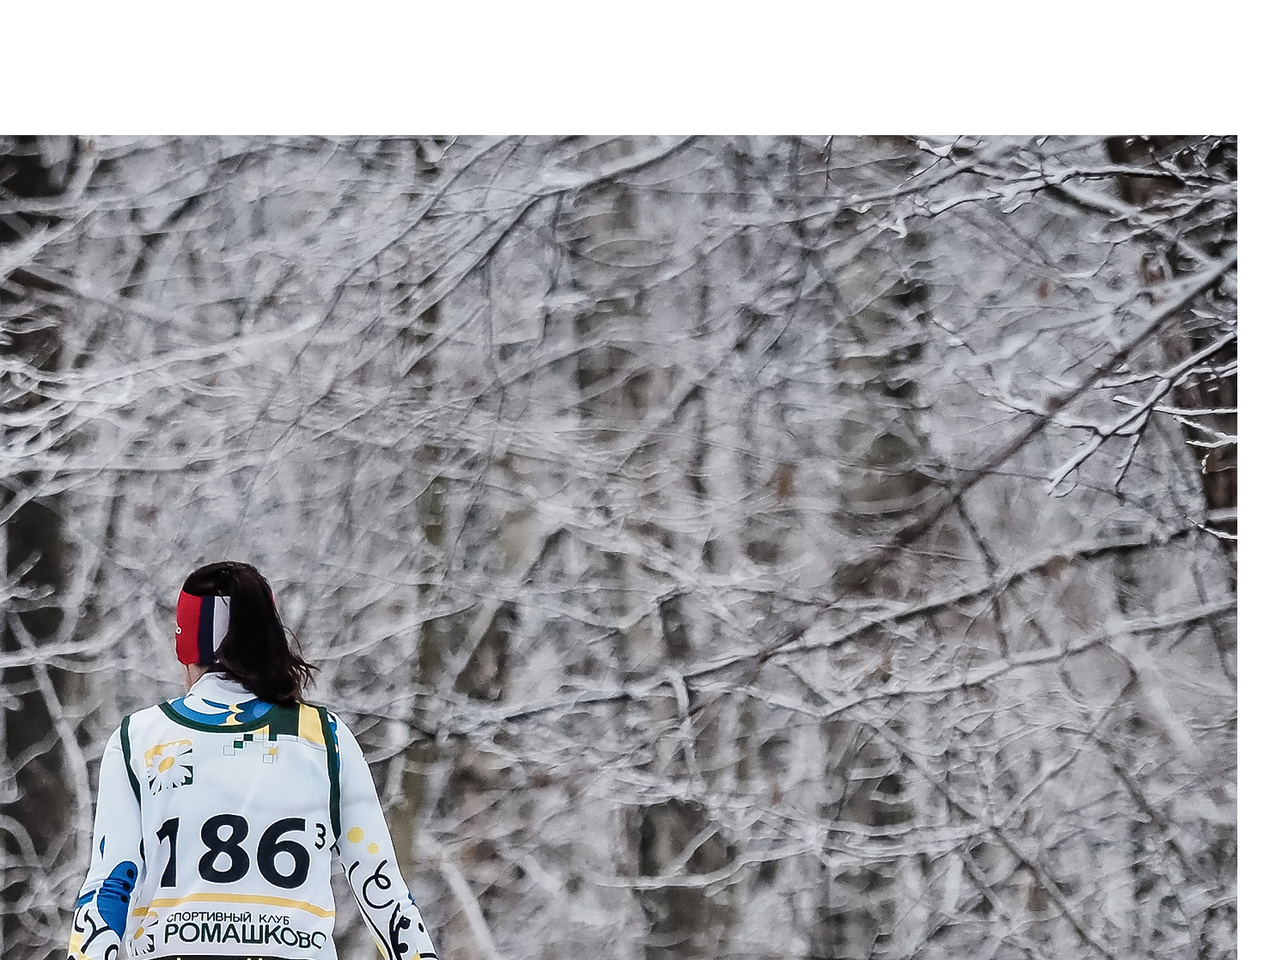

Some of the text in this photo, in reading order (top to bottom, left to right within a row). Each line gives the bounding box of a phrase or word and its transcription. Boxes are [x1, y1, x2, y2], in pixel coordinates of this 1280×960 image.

[156, 814, 310, 889] 186
[166, 911, 290, 925] СПОРТИВНЫЙ КЛУБ
